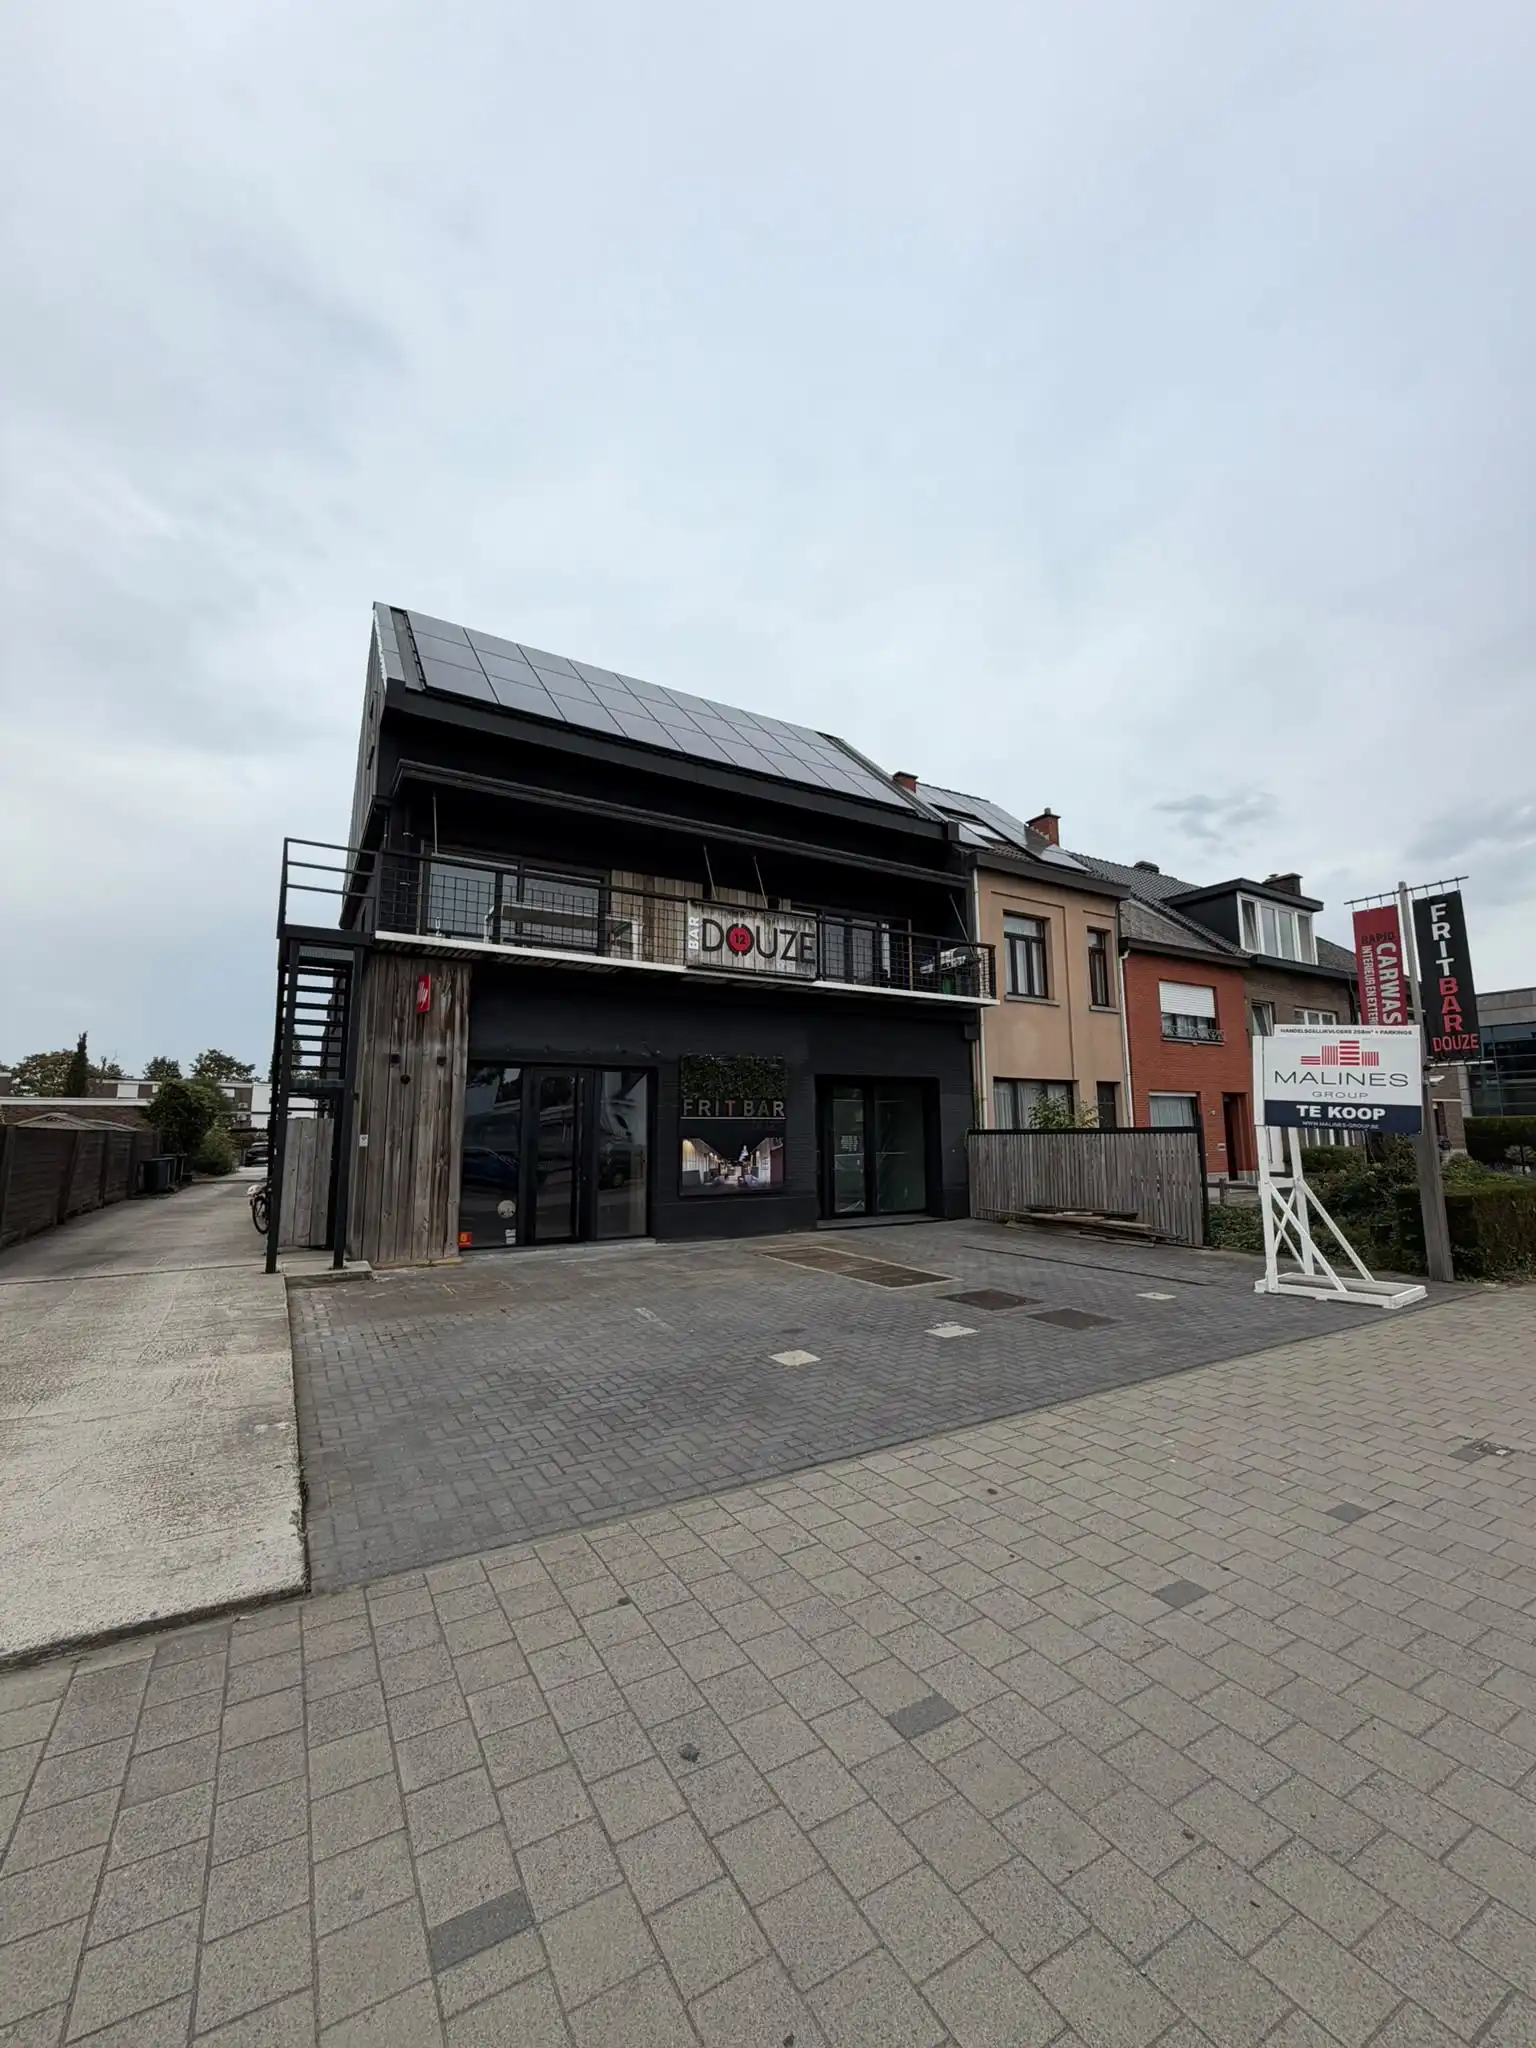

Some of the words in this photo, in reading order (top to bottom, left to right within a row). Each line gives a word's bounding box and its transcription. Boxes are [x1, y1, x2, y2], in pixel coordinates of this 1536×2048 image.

[688, 916, 700, 950] BAR
[702, 918, 816, 965] DOUZE
[734, 933, 746, 946] 12
[1361, 931, 1395, 945] RAPID
[1376, 942, 1402, 1025] CARWAS
[1366, 998, 1379, 1026] EXTERI
[1432, 1033, 1480, 1052] DOUZE
[1274, 1070, 1409, 1088] MALINES
[1311, 1090, 1369, 1099] GROUP
[1295, 1104, 1322, 1118] TE
[1327, 1106, 1386, 1121] KOOP
